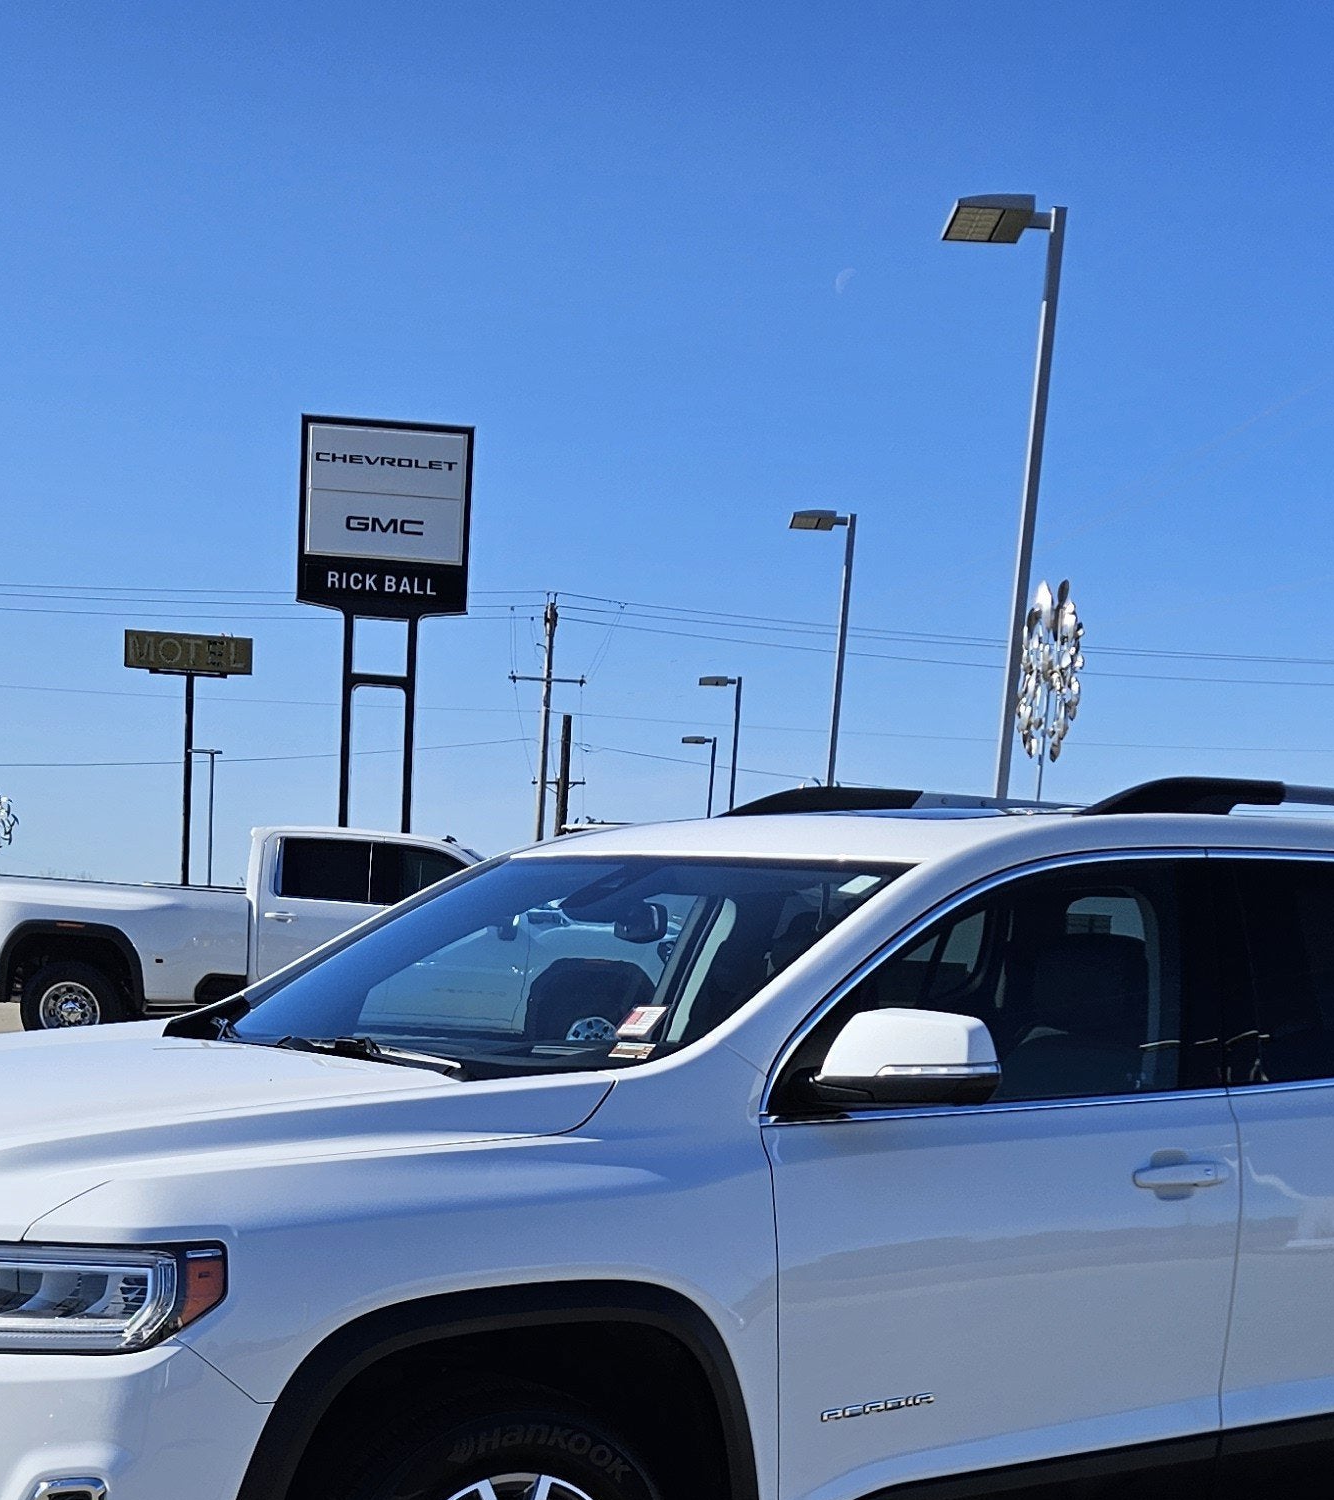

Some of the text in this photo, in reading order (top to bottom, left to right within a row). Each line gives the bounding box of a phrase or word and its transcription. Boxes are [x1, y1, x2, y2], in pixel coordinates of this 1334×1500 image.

[315, 451, 459, 472] CHEVROLET
[345, 515, 425, 536] GMC
[326, 570, 437, 596] RICK BALL
[127, 633, 247, 669] MOTEL
[820, 1391, 936, 1423] ACADIA
